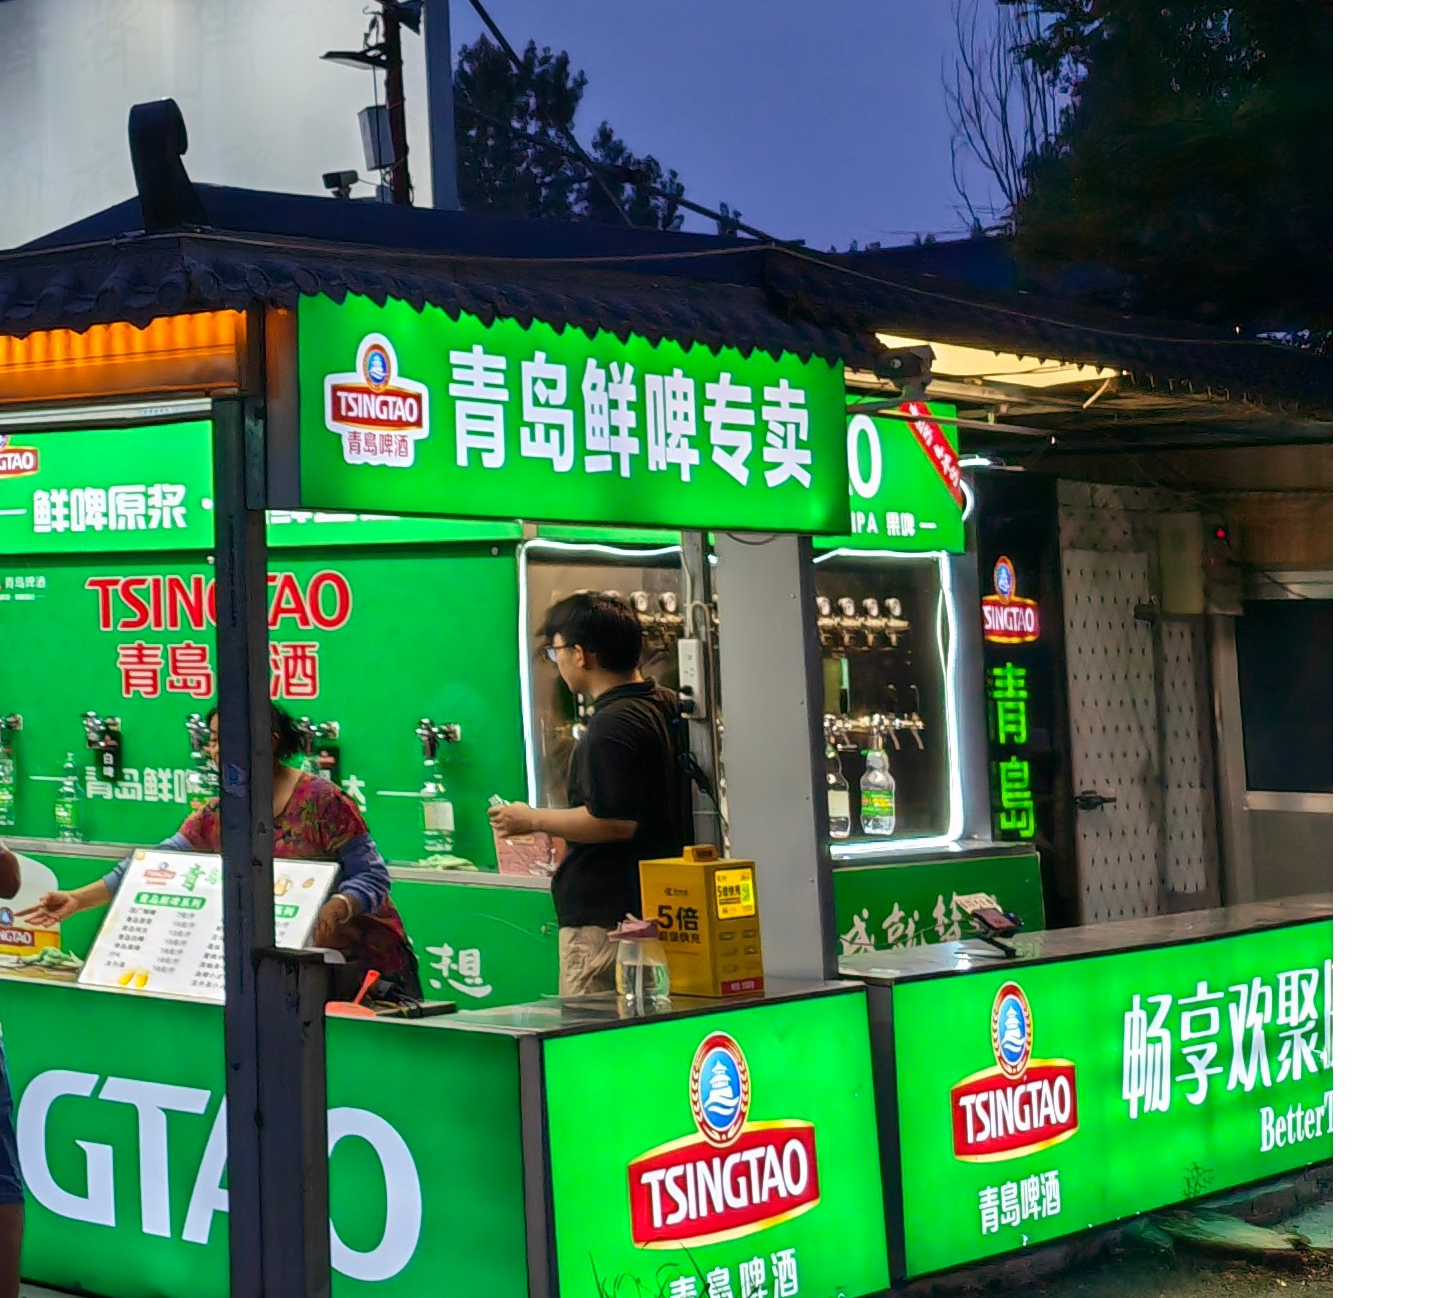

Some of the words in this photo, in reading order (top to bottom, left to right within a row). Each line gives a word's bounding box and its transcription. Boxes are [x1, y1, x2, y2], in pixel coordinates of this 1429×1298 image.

[336, 391, 418, 423] TSINGTAO
[448, 344, 813, 490] 青岛鲜啤专卖
[33, 483, 188, 534] 鲜啤原浆
[86, 570, 352, 632] TSINAO
[982, 603, 1036, 634] SINGTAO
[117, 640, 319, 699] 青島酒
[657, 904, 700, 932] 5倍
[957, 1074, 1071, 1146] TSINGTAO
[640, 1138, 809, 1230] TSINGTAO
